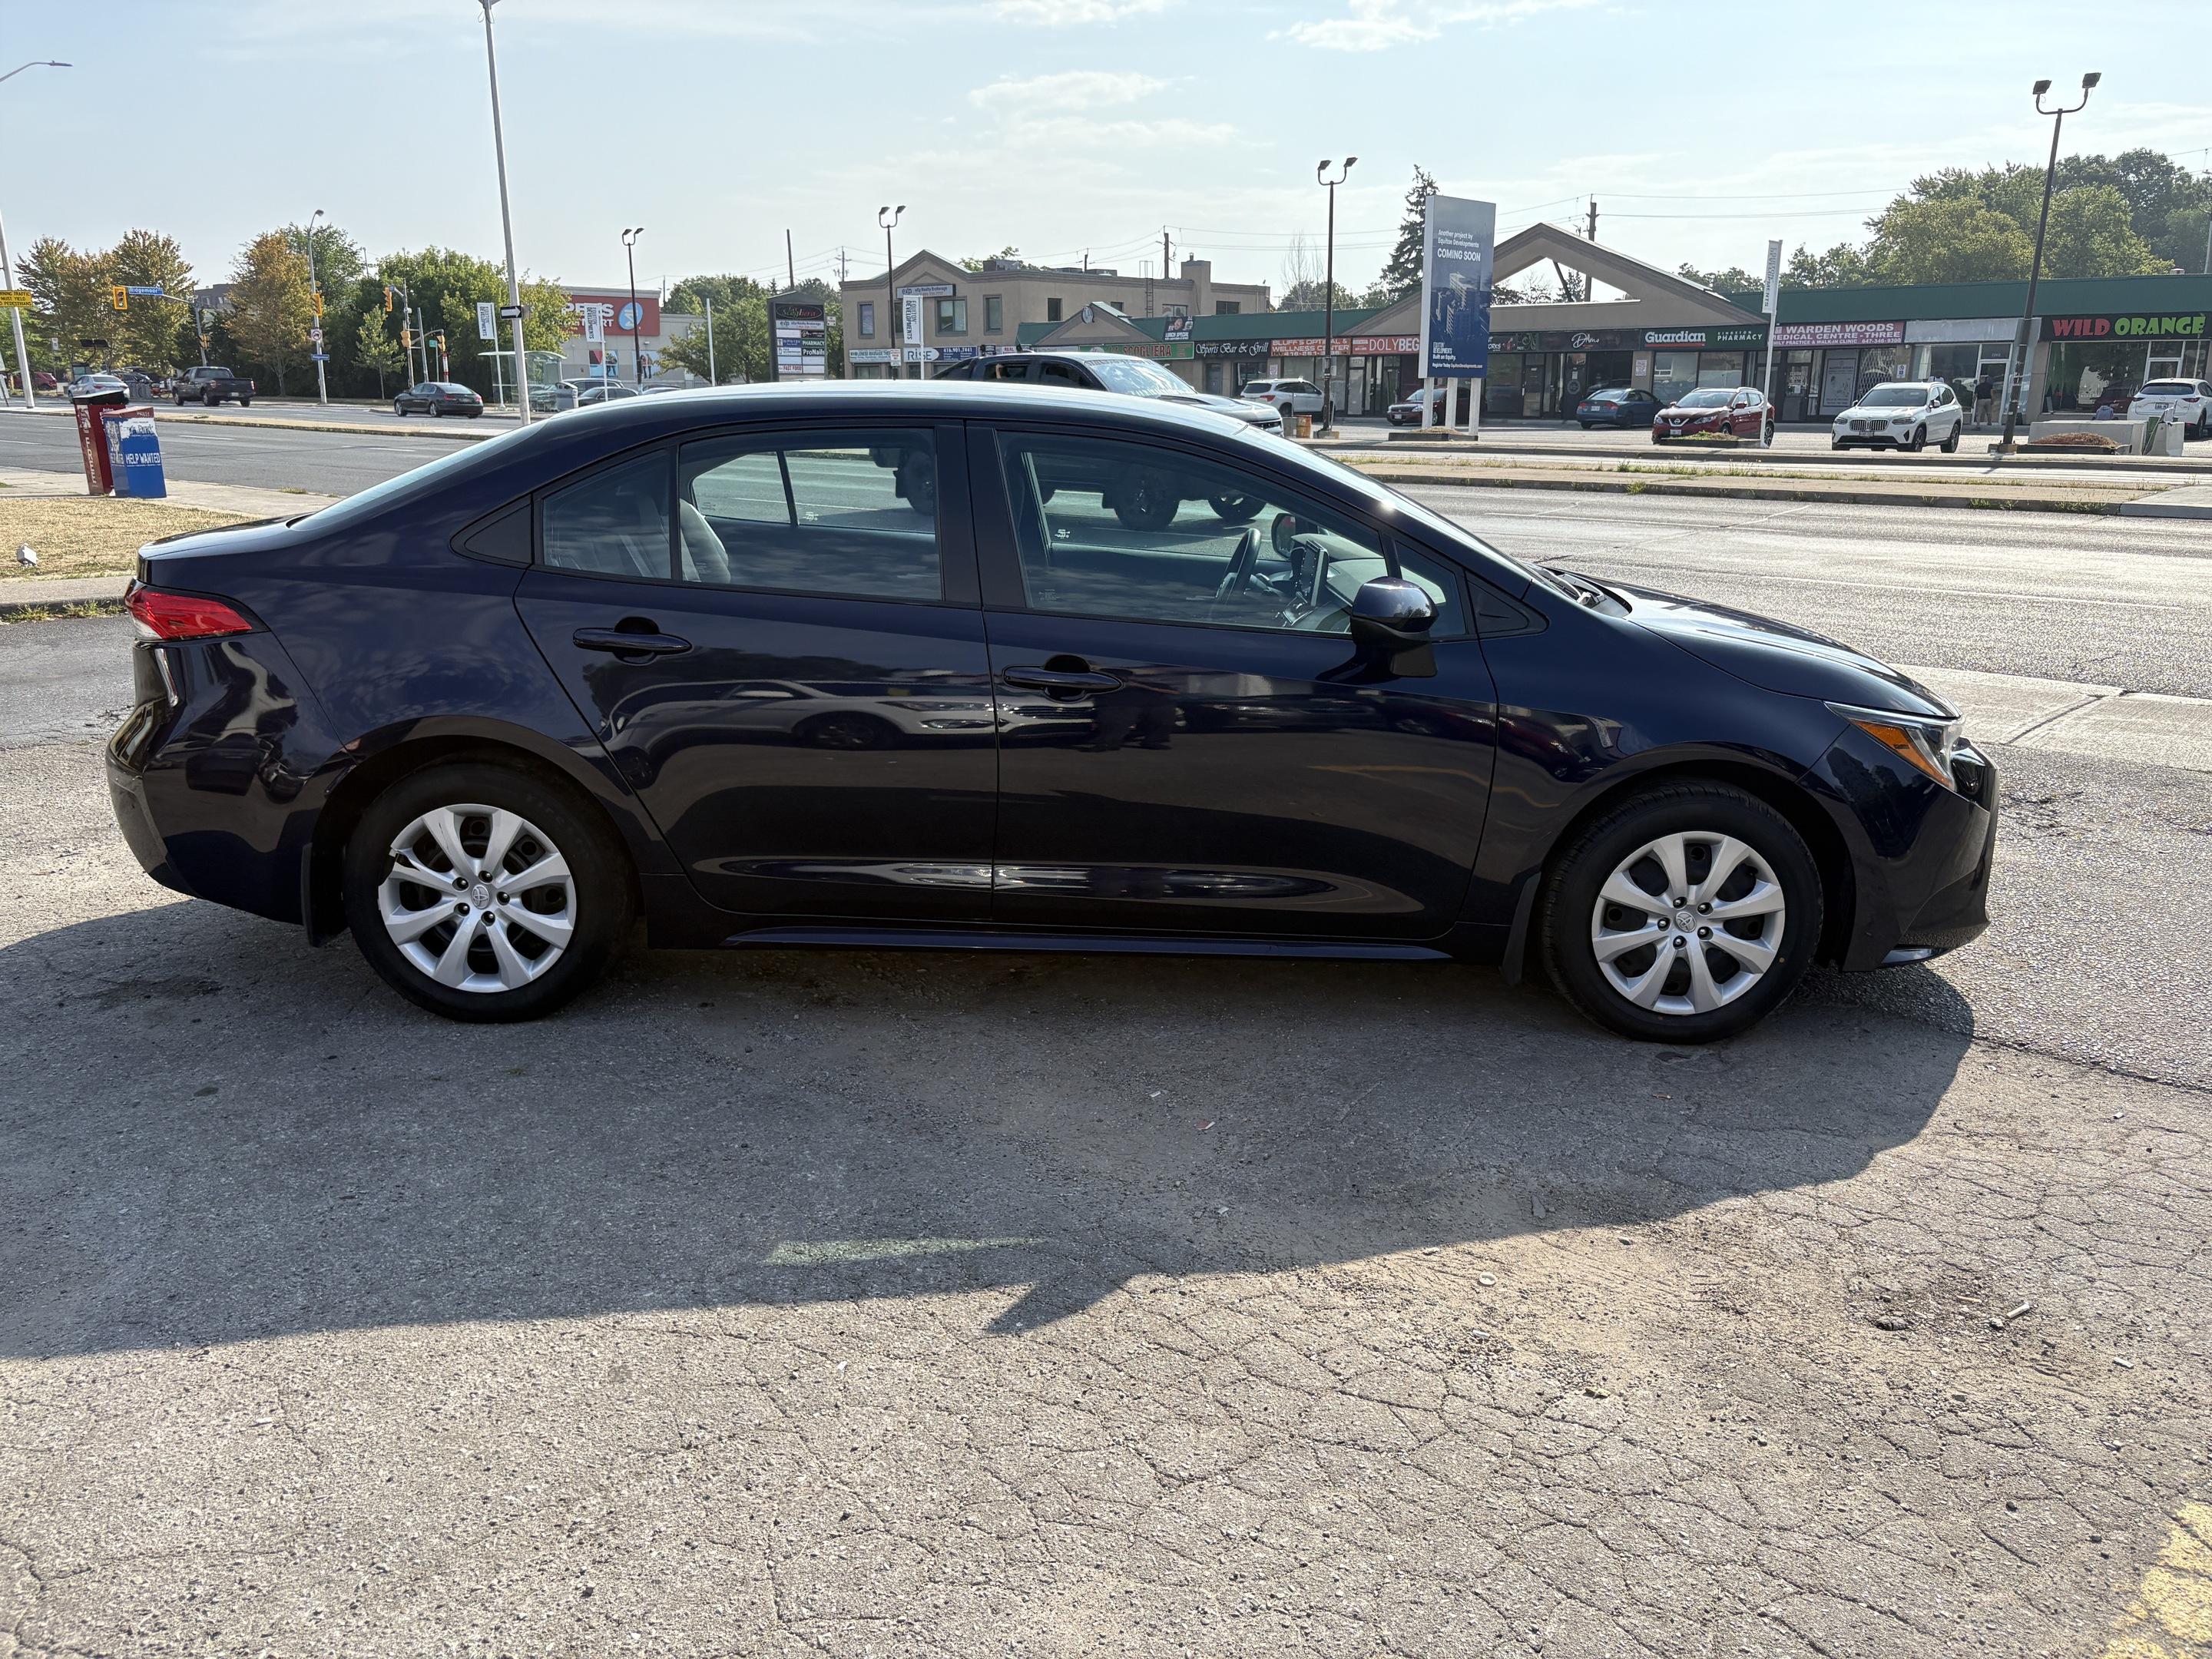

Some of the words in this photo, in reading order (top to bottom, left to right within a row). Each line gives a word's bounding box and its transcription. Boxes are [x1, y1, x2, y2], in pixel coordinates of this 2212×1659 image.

[1454, 232, 1468, 240] project
[1453, 239, 1479, 248] Developments
[1437, 247, 1462, 260] COMING
[1463, 251, 1481, 261] SOON
[586, 307, 594, 339] DEVELOPMENTS
[1786, 325, 1841, 334] WARDEN
[1845, 323, 1895, 332] WOODS
[2052, 318, 2111, 336] WILD
[2114, 316, 2206, 336] ORANGE
[1644, 330, 1706, 343] Guardian
[1123, 345, 1172, 357] SCOGLIERA
[1196, 343, 1219, 357] Sports
[1220, 343, 1238, 353] Bar
[1239, 343, 1248, 353] &
[1249, 342, 1269, 356] Grill
[85, 437, 97, 484] FREE
[125, 453, 139, 464] HELP
[139, 452, 161, 464] WANTED
